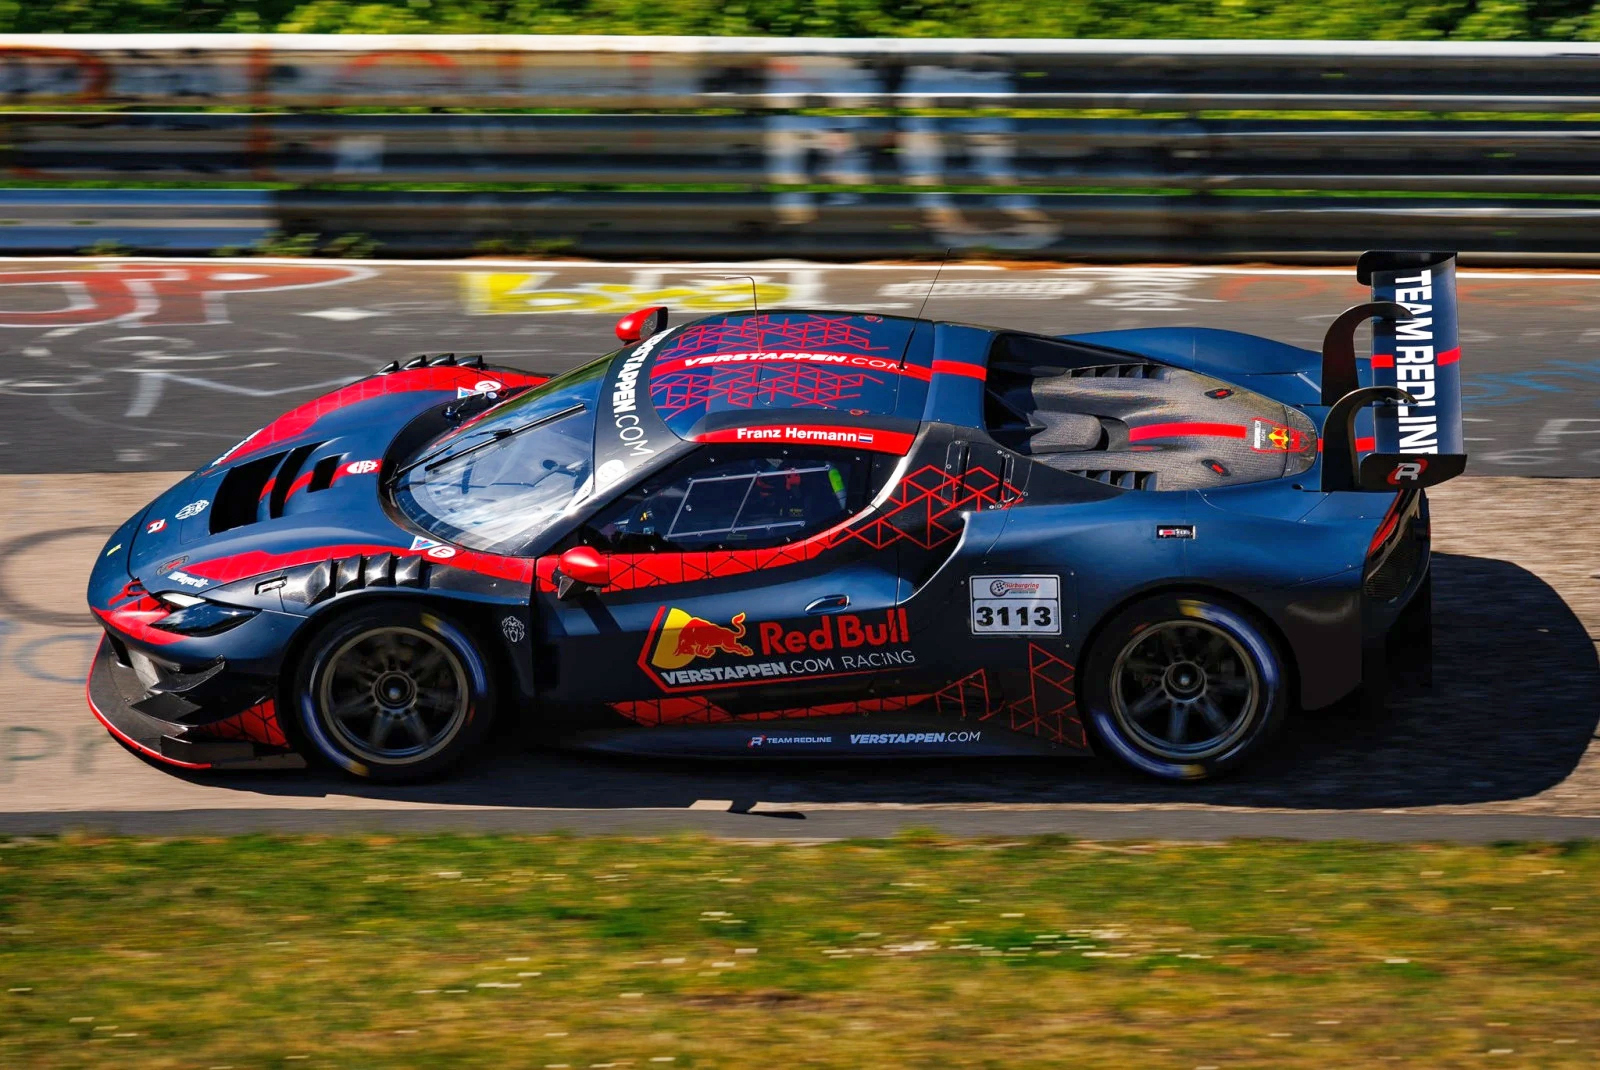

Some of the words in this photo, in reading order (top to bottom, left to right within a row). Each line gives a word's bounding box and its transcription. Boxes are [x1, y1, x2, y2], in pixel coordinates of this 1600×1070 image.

[1395, 269, 1433, 341] TEAM
[737, 428, 781, 440] Franz
[785, 427, 857, 442] Hermann
[976, 606, 1052, 627] 3113
[759, 615, 834, 656] Red
[837, 608, 910, 649] Bull
[660, 655, 834, 686] VERSTAPPEN.COM
[843, 649, 916, 669] RACING
[850, 731, 982, 745] VERSTAPPEN.COM
